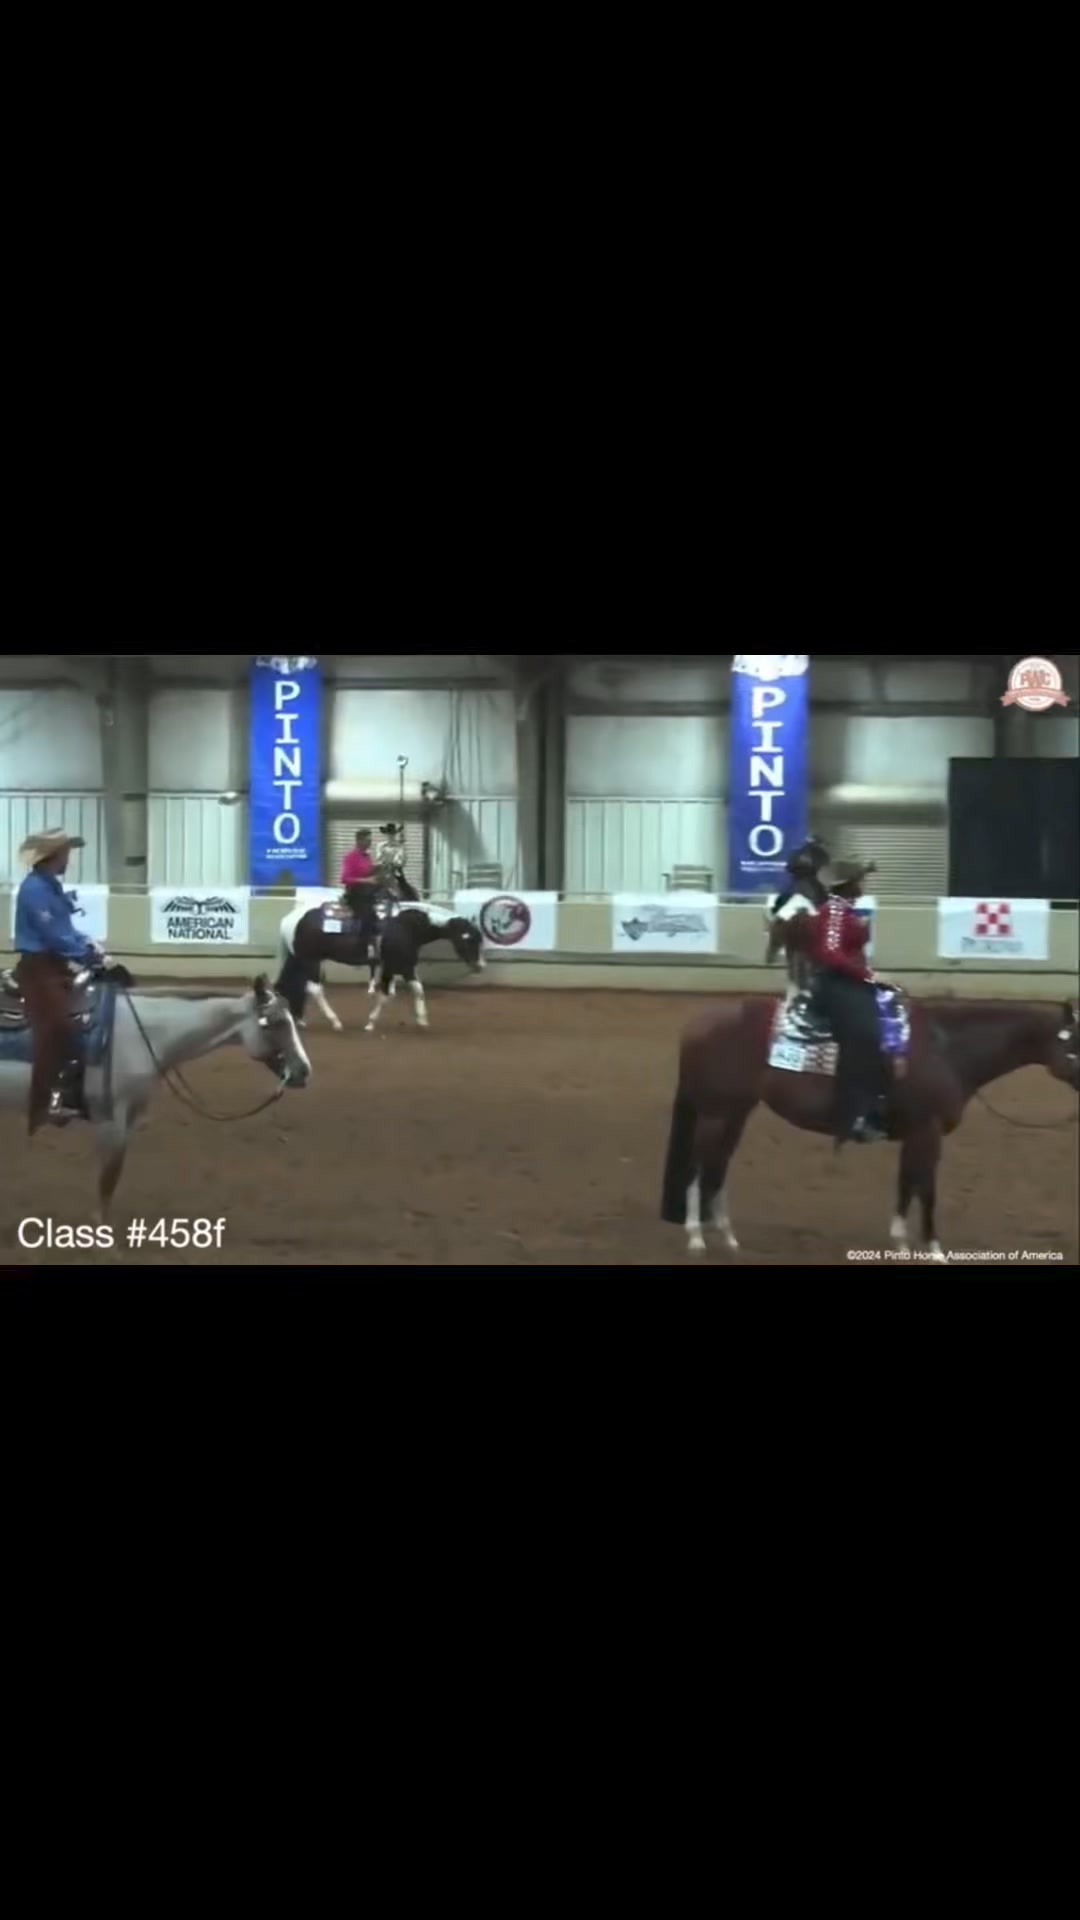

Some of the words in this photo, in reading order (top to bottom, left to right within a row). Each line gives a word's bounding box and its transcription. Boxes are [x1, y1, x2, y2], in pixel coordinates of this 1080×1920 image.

[273, 680, 303, 844] PINTO
[748, 686, 787, 856] PINTO
[167, 917, 234, 928] AMERICAN
[168, 928, 232, 940] NATIONAL
